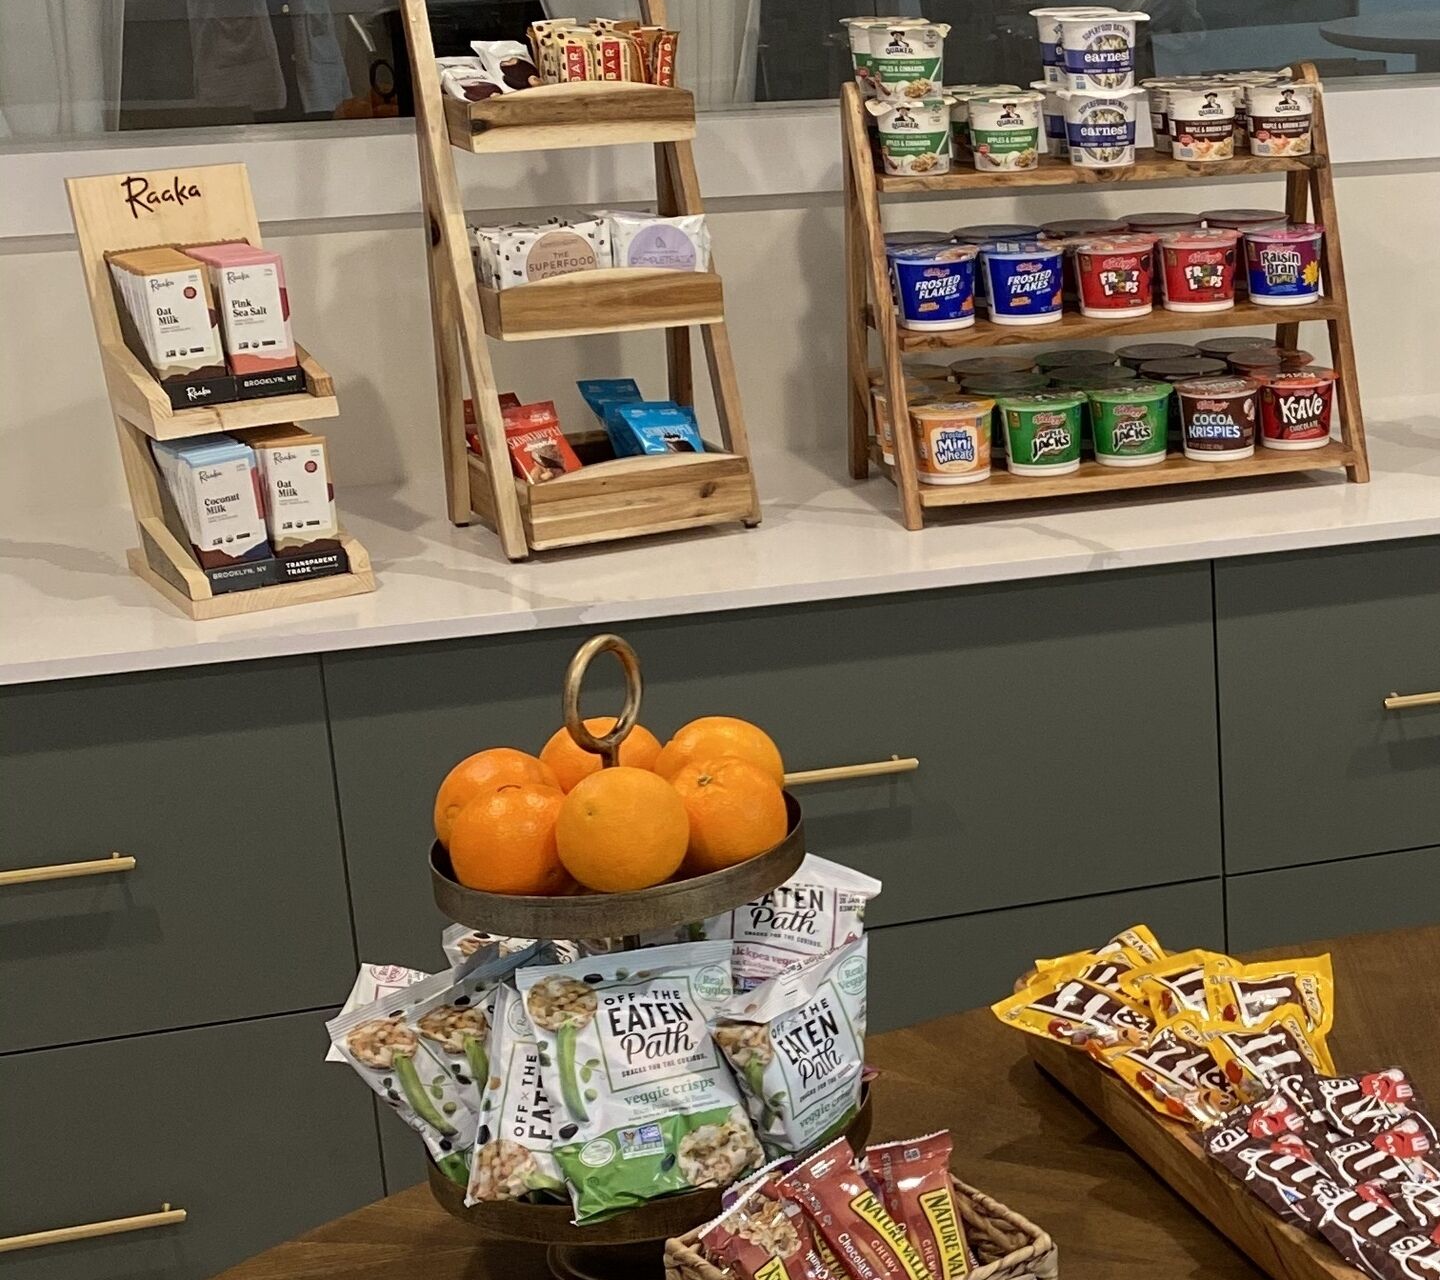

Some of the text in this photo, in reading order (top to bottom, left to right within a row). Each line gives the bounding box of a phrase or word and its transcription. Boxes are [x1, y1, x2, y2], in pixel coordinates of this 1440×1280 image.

[886, 47, 914, 55] QUAKER
[1084, 51, 1129, 62] earnest
[892, 122, 919, 130] QUAKER
[997, 119, 1024, 127] QUAKER
[1081, 125, 1127, 136] earnest
[121, 176, 201, 219] Raaka
[529, 256, 595, 272] SUPERFOOD
[1261, 250, 1300, 265] Raisin
[1267, 262, 1298, 277] Bran
[915, 275, 960, 291] FROSTED
[1008, 270, 1052, 286] FROSTED
[919, 285, 957, 300] FLAKES
[1011, 280, 1049, 295] FLAKES
[231, 298, 252, 308] Pink
[156, 307, 172, 317] Oat
[233, 306, 267, 318] Sea Salt
[158, 315, 179, 326] Milk
[244, 374, 297, 389] BROOKLYN, NY
[1193, 414, 1234, 425] COCOA
[1113, 427, 1151, 452] JACKS
[1189, 426, 1241, 438] KRISPIES
[937, 436, 972, 452] Mini
[1032, 435, 1070, 463] JACKS
[935, 448, 975, 464] Wheats
[277, 480, 292, 489] Oat
[204, 493, 240, 506] Coconut
[278, 488, 298, 498] Milk
[206, 506, 227, 516] Milk
[285, 555, 338, 569] TRANSPARENT
[287, 567, 312, 576] TRADE
[750, 906, 816, 935] Path
[703, 976, 724, 987] Real
[694, 984, 731, 996] Veggies
[604, 990, 681, 1006] OFF THE
[608, 1002, 693, 1037] EATEN
[771, 998, 829, 1038] OFF THE
[620, 1022, 694, 1064] Path
[777, 1010, 839, 1066] EATEN
[799, 1037, 842, 1089] Path
[514, 1054, 538, 1137] OFF THE
[624, 1076, 715, 1106] veggie crisps
[857, 1195, 904, 1246] NATURE
[924, 1193, 957, 1254] NATURE
[837, 1232, 873, 1280] Chocolate
[870, 1239, 899, 1274] CHEWY
[805, 1249, 829, 1280] Chunk
